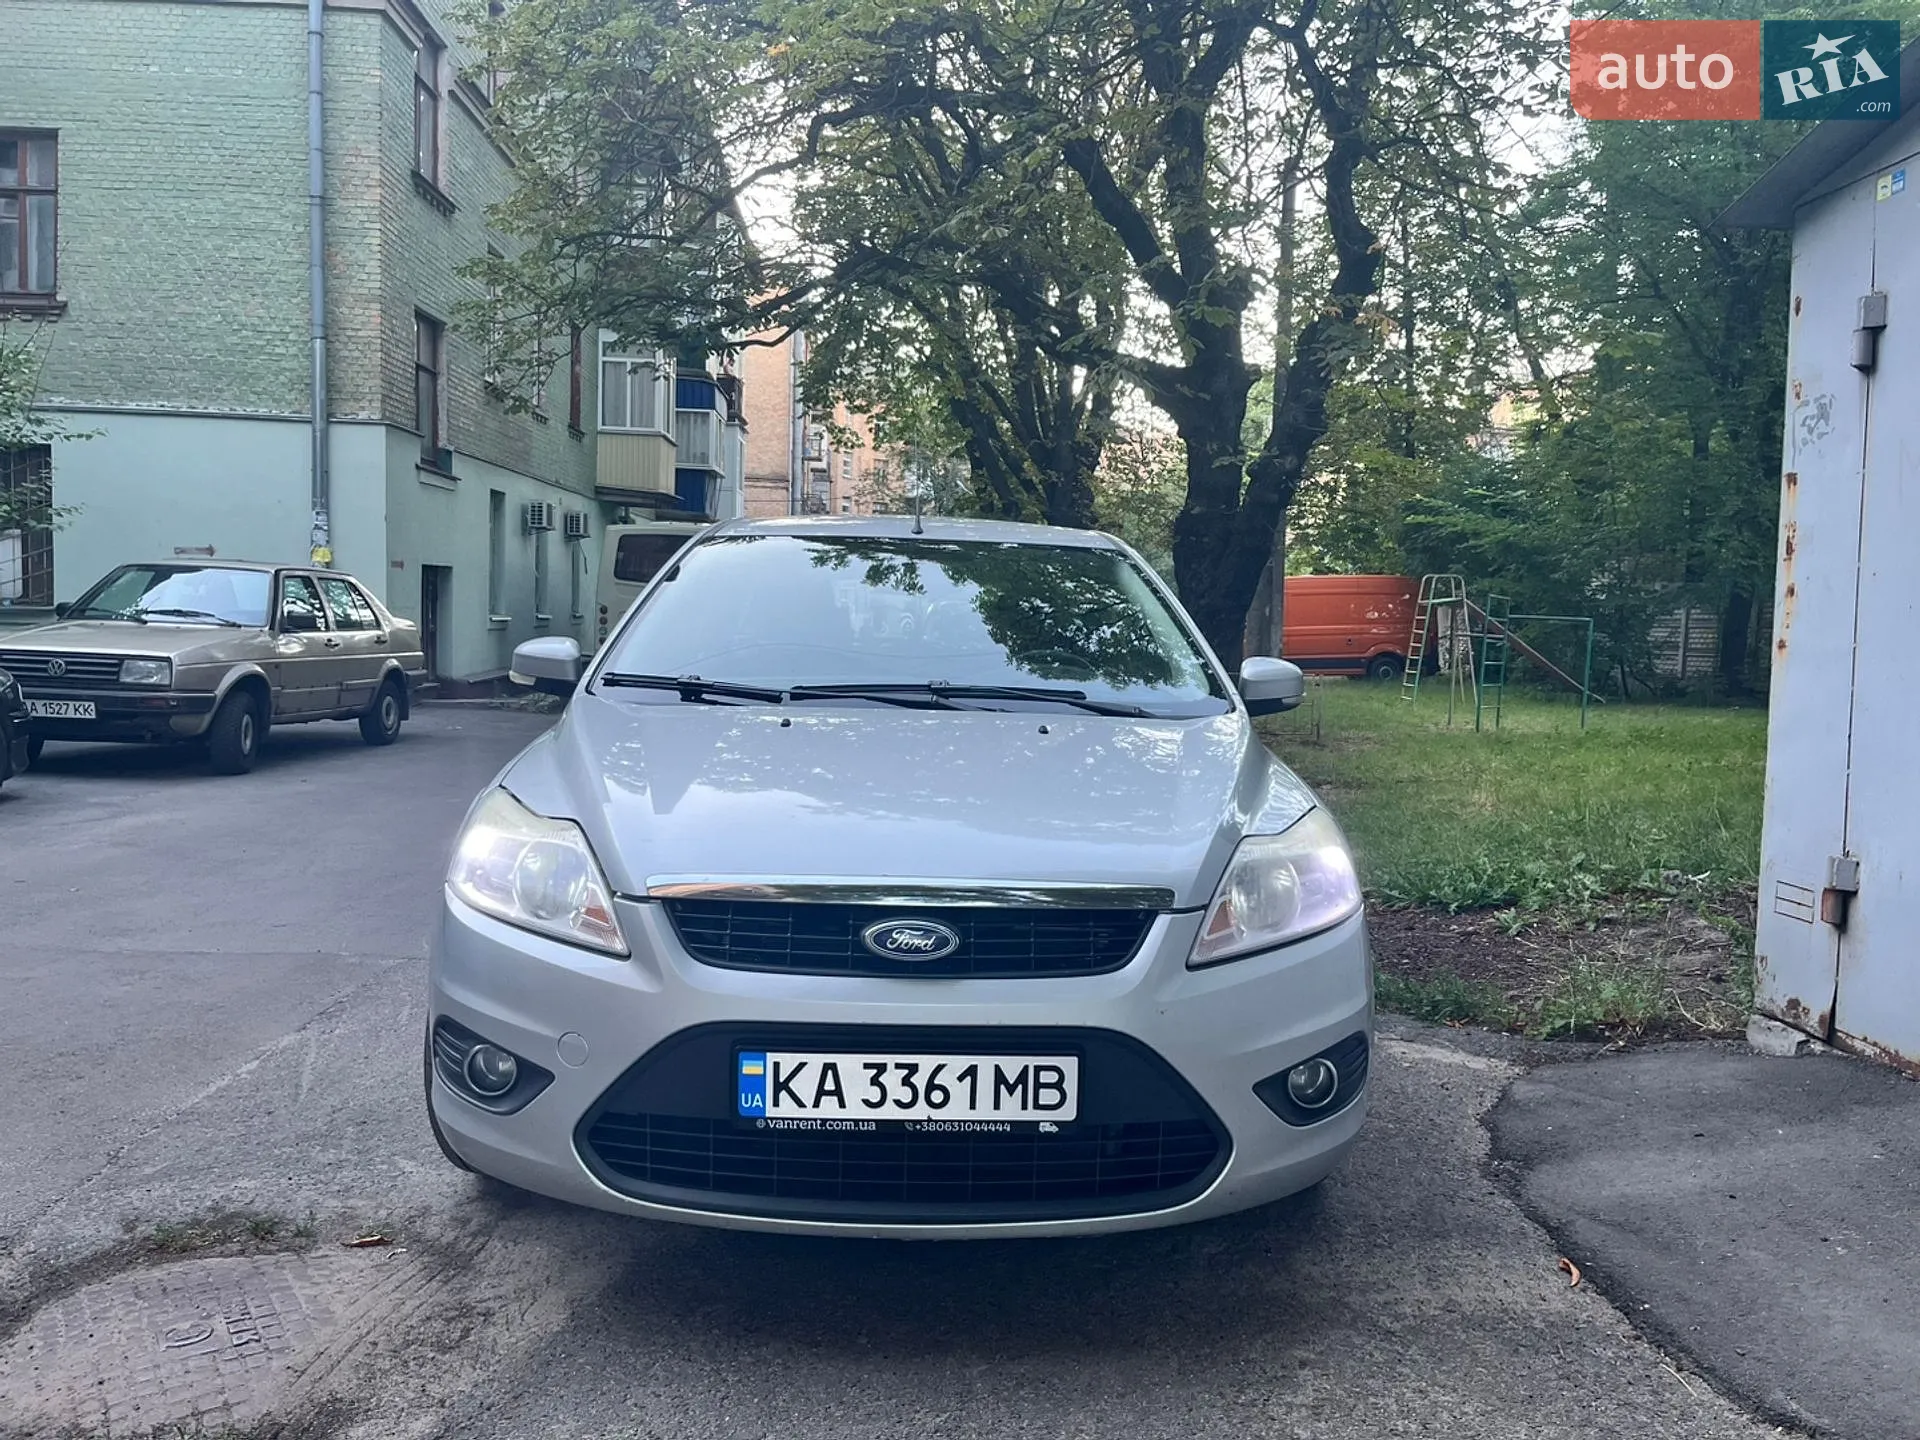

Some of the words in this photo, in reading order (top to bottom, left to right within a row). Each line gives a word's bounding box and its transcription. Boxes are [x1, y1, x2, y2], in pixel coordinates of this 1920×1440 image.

[42, 702, 70, 716] 1527
[73, 703, 94, 716] KK
[886, 928, 936, 950] Ford
[772, 1061, 847, 1109] KA
[861, 1062, 979, 1111] 3361
[994, 1064, 1068, 1111] MB
[741, 1093, 764, 1109] UA
[767, 1118, 877, 1132] vanrent.com.ua
[914, 1121, 1011, 1132] +380631044444
